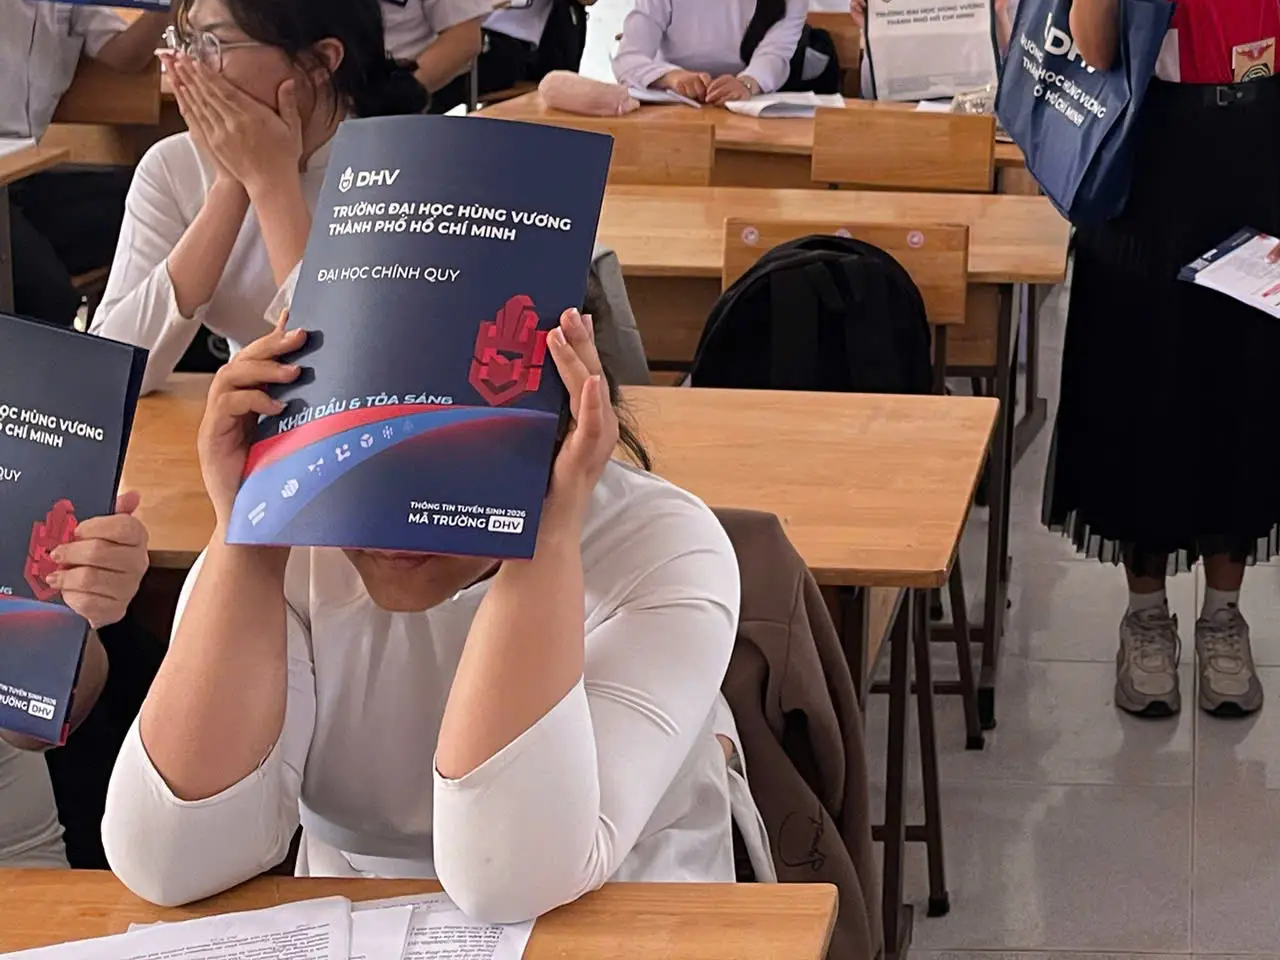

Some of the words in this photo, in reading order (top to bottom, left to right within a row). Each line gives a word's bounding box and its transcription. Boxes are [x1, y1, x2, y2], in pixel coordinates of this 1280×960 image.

[356, 169, 400, 187] DHV
[328, 219, 372, 236] THÀNH
[374, 215, 408, 233] PHỐ
[409, 217, 435, 233] HỒ
[437, 220, 469, 236] CHÍ
[470, 224, 516, 241] MINH
[333, 201, 385, 218] TRƯỜNG
[388, 202, 416, 217] ĐẠI
[418, 203, 455, 219] HỌC
[457, 204, 507, 221] HÙNG
[511, 210, 572, 231] VƯƠNG
[317, 268, 339, 283] ĐẠI
[340, 266, 369, 282] HỌC
[371, 263, 420, 281] CHÍNH
[424, 267, 461, 282] QUY
[0, 404, 19, 420] ỌC
[20, 409, 57, 429] HÙNG
[59, 418, 104, 441] VƯƠNG
[278, 407, 313, 434] KHỞI
[314, 397, 347, 418] ĐẦU
[402, 392, 454, 405] SÁNG
[5, 423, 29, 439] CHÍ
[29, 428, 64, 448] MINH
[408, 512, 429, 524] MÃ
[432, 514, 486, 529] TRƯỜNG
[491, 518, 522, 531] DHV
[410, 501, 440, 511] THÔNG
[442, 503, 456, 512] TIN
[485, 507, 505, 515] SINH
[506, 509, 526, 518] 2026
[0, 693, 28, 711] ƯỜNG
[30, 702, 53, 718] DHV
